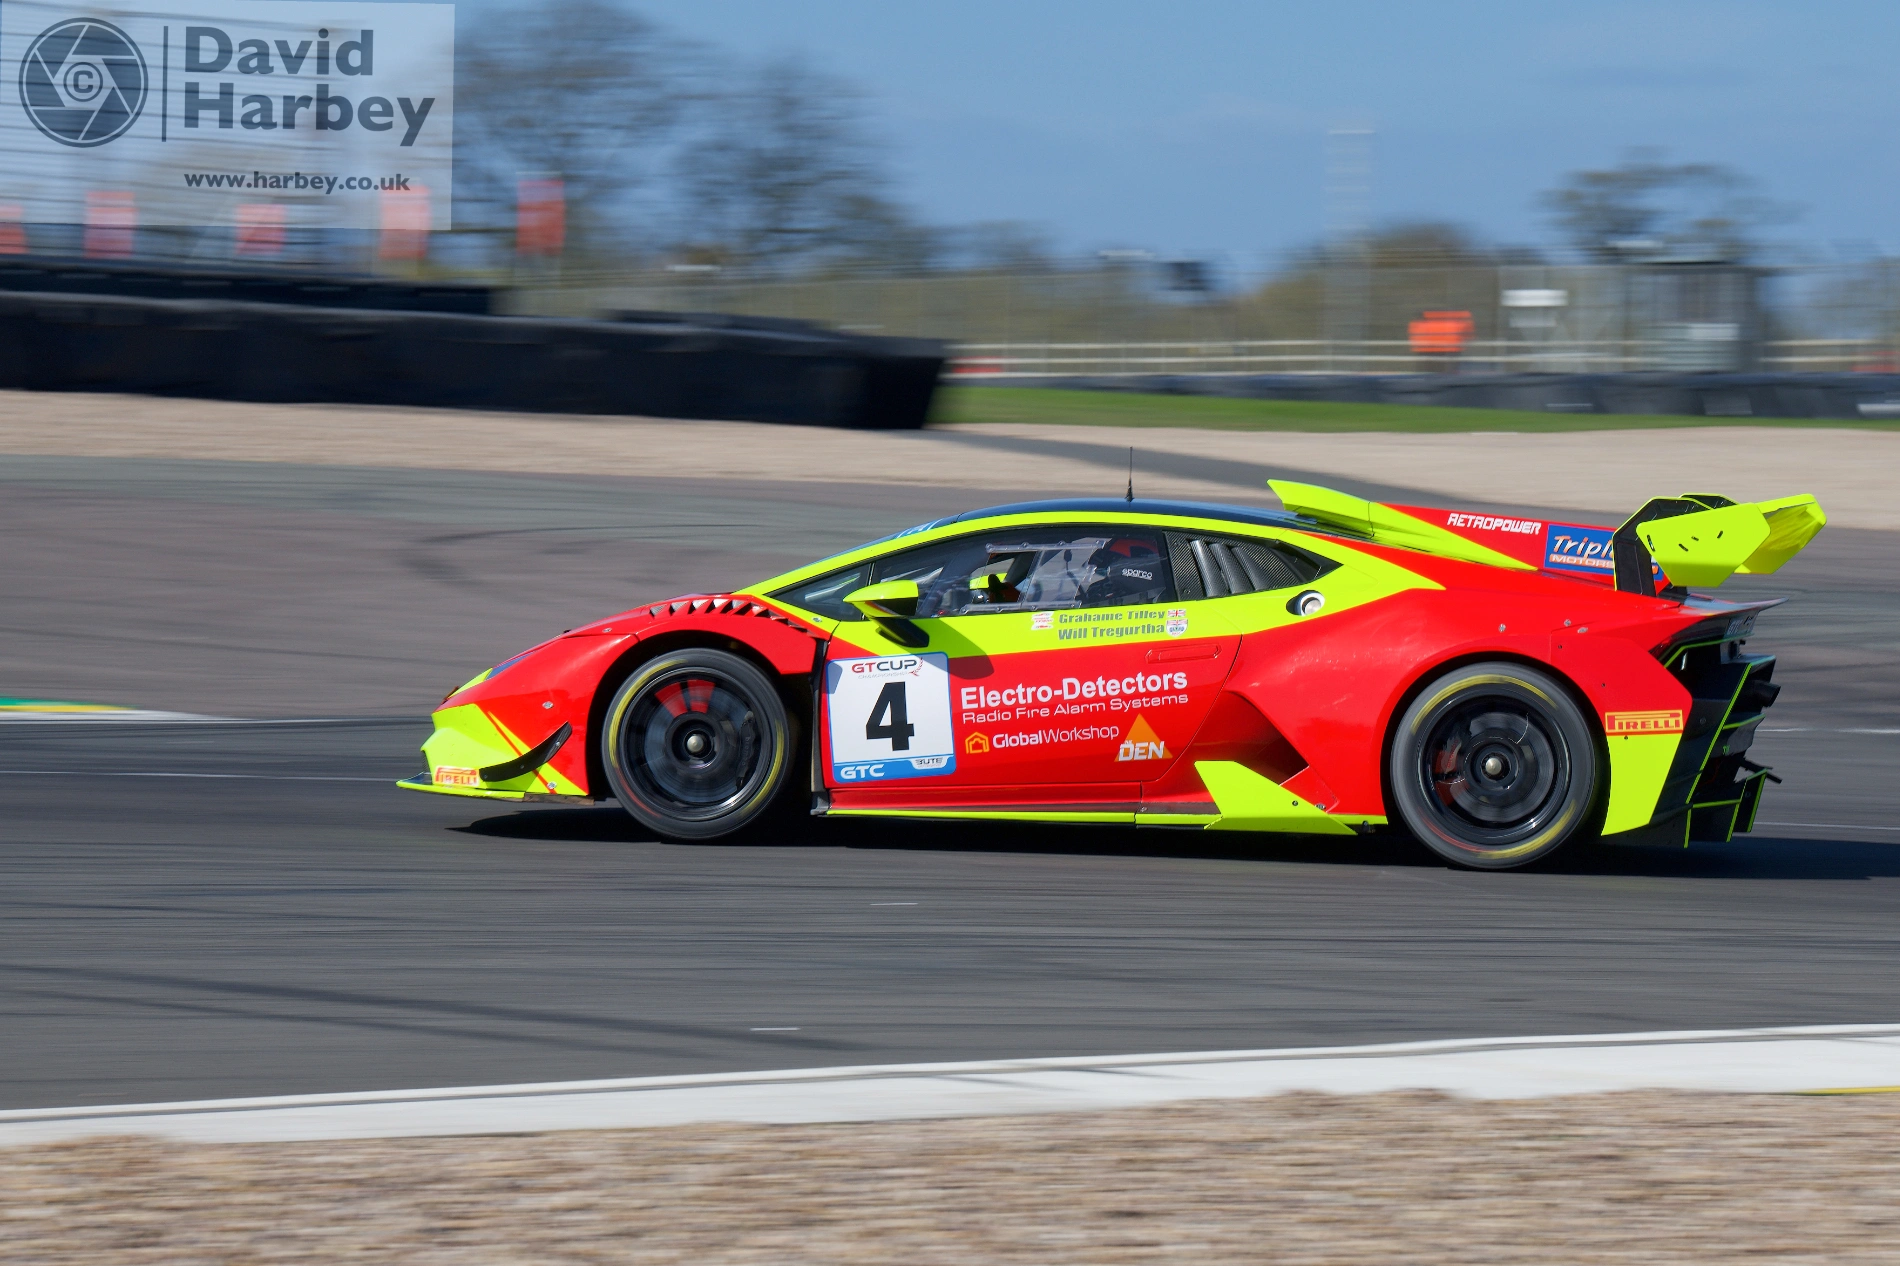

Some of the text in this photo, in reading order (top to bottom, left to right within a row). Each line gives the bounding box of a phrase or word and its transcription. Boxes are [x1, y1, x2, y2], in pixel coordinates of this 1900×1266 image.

[1447, 512, 1542, 535] RETROPOWER
[1122, 568, 1153, 580] sparco
[1059, 613, 1123, 624] Grahame
[1127, 610, 1165, 620] Tilley
[1058, 628, 1087, 640] Will
[1091, 623, 1165, 638] Tregurtha
[961, 671, 1188, 710] Electro-Detectors
[866, 681, 915, 751] 4
[962, 694, 1189, 724] Radio Fire Alarm Systems
[1607, 712, 1681, 730] PIRELLI
[435, 767, 477, 785] PIRELLI
[840, 764, 885, 779] GTC
